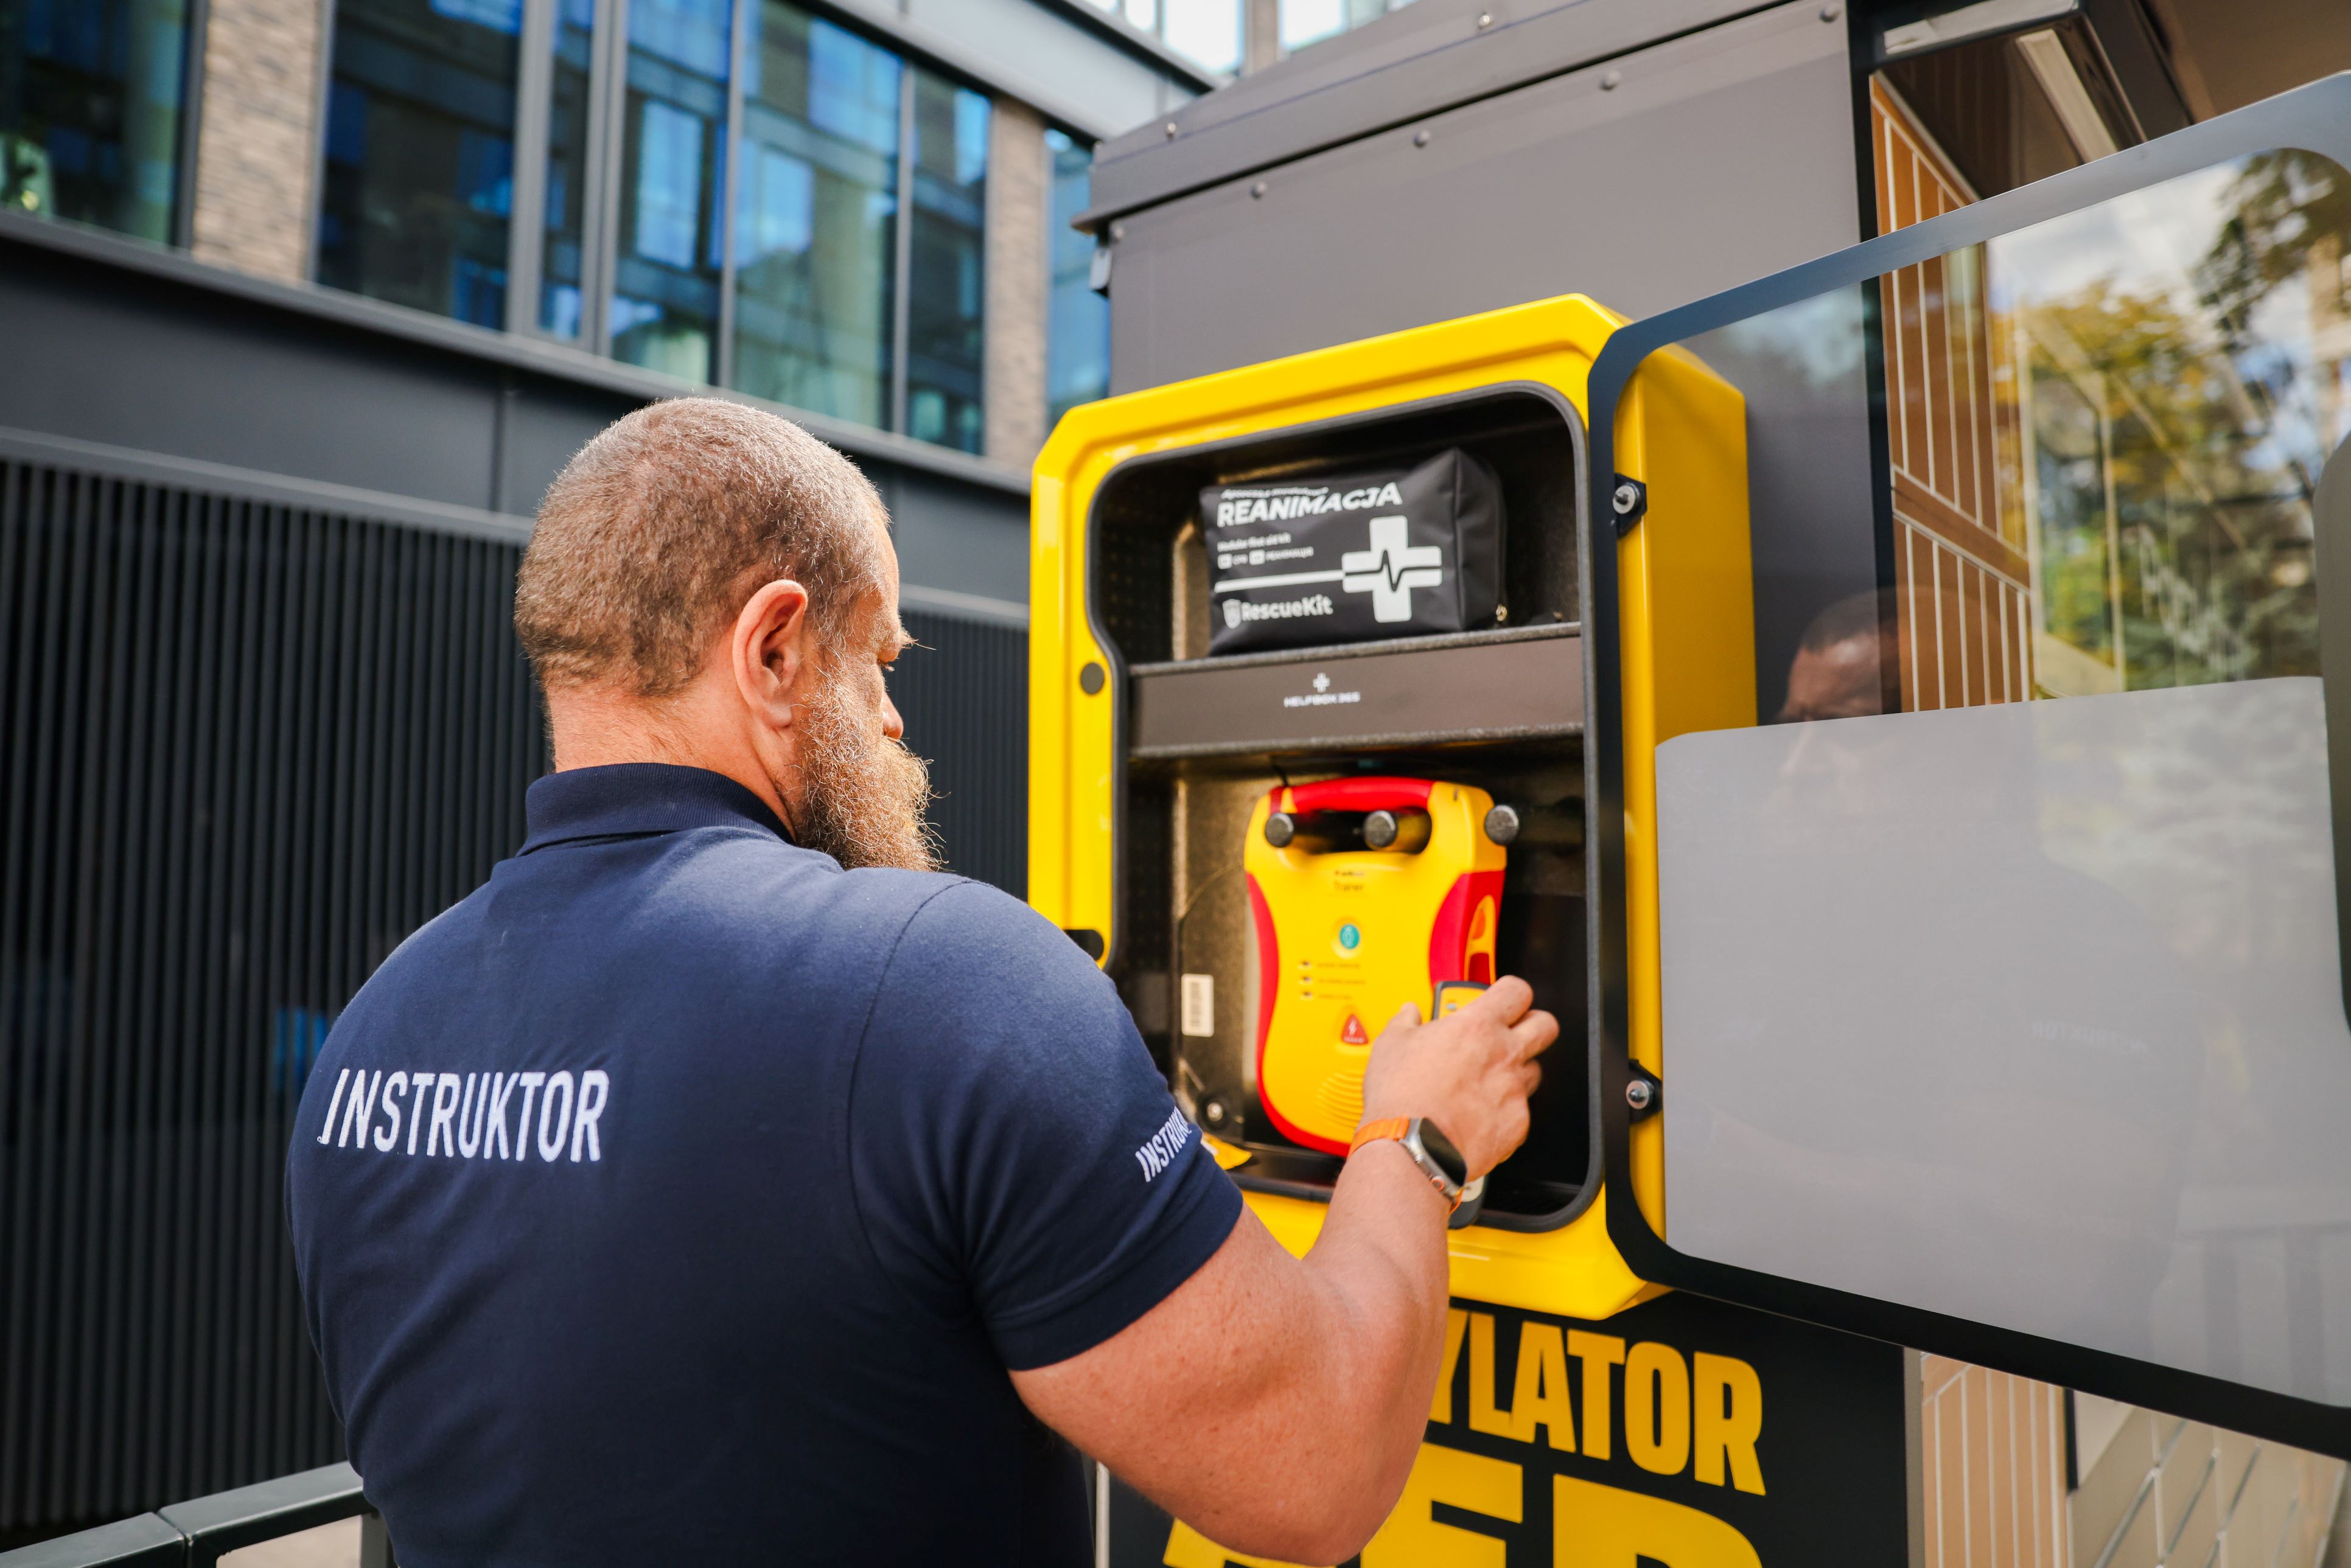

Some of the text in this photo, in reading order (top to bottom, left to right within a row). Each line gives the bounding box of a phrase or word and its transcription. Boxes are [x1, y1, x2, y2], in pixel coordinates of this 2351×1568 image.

[1217, 482, 1402, 528] REANIMACJA
[1241, 594, 1333, 621] RescueKit
[318, 1068, 609, 1162] INSTRUKTOR
